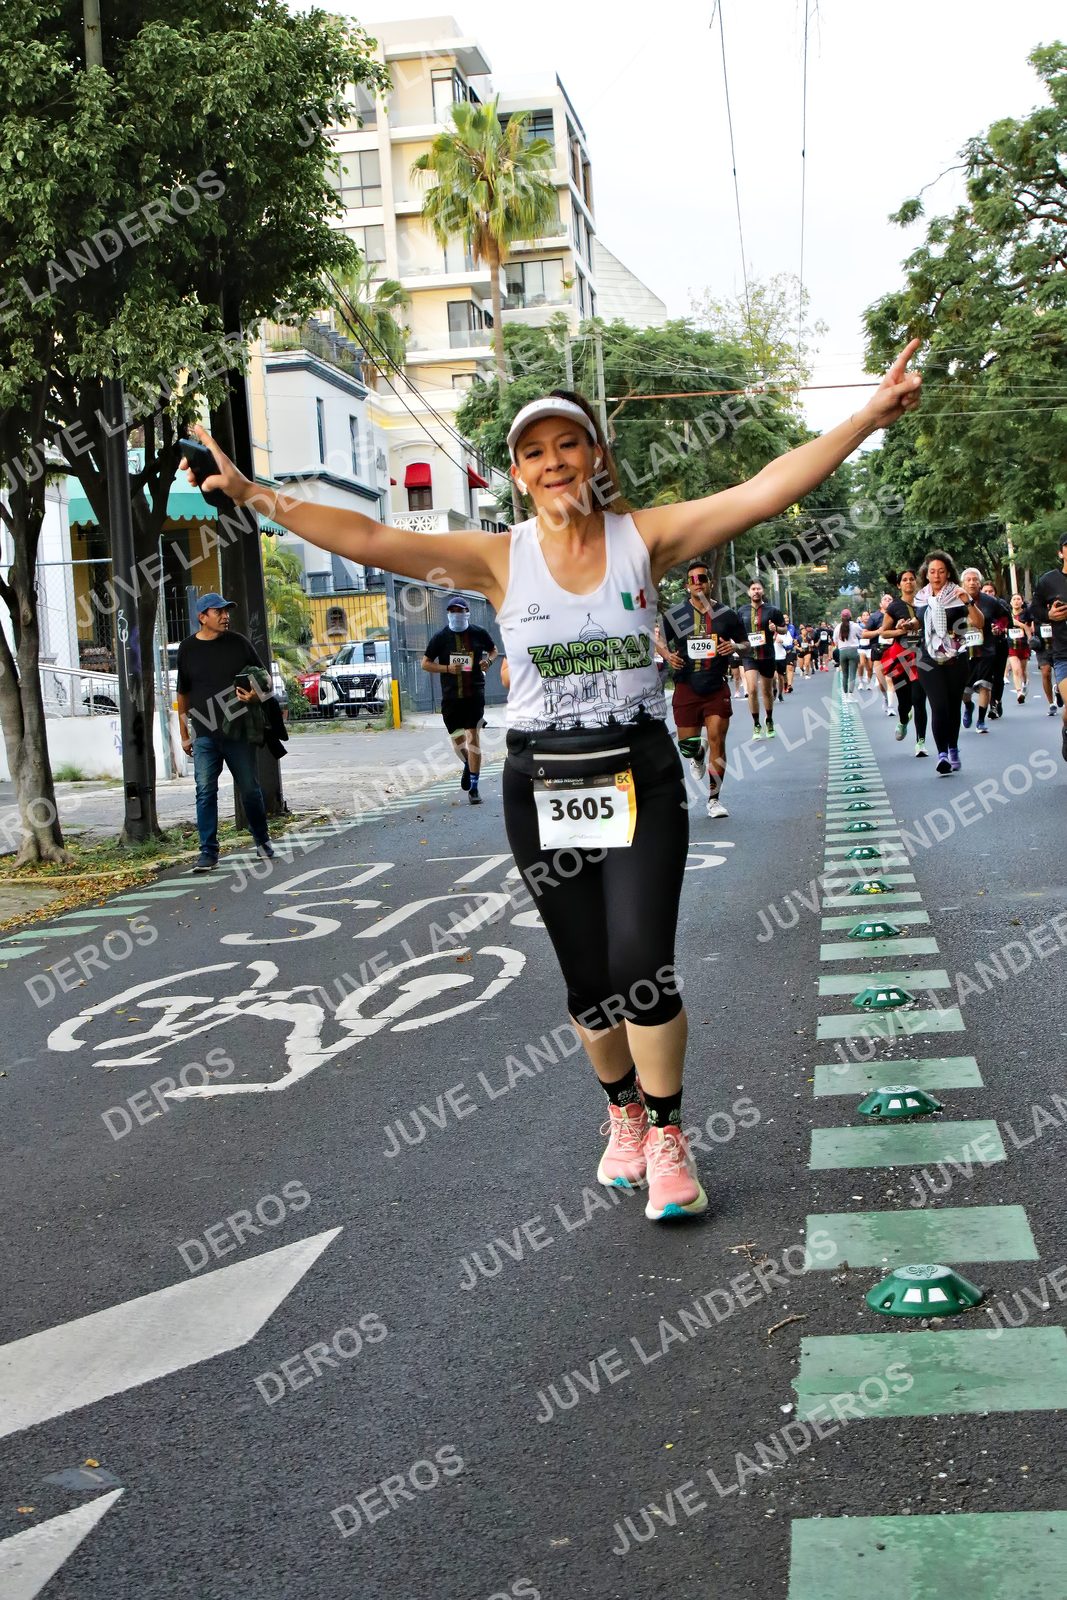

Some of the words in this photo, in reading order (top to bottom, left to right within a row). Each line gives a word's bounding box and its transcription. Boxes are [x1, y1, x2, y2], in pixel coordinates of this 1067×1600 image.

[520, 614, 551, 624] TOPTIME
[528, 633, 651, 665] ZAPOPAN
[690, 641, 712, 651] 4296
[452, 657, 469, 665] 6924
[536, 651, 652, 678] RUNNERS
[616, 774, 630, 784] 5K
[549, 796, 614, 821] 3605
